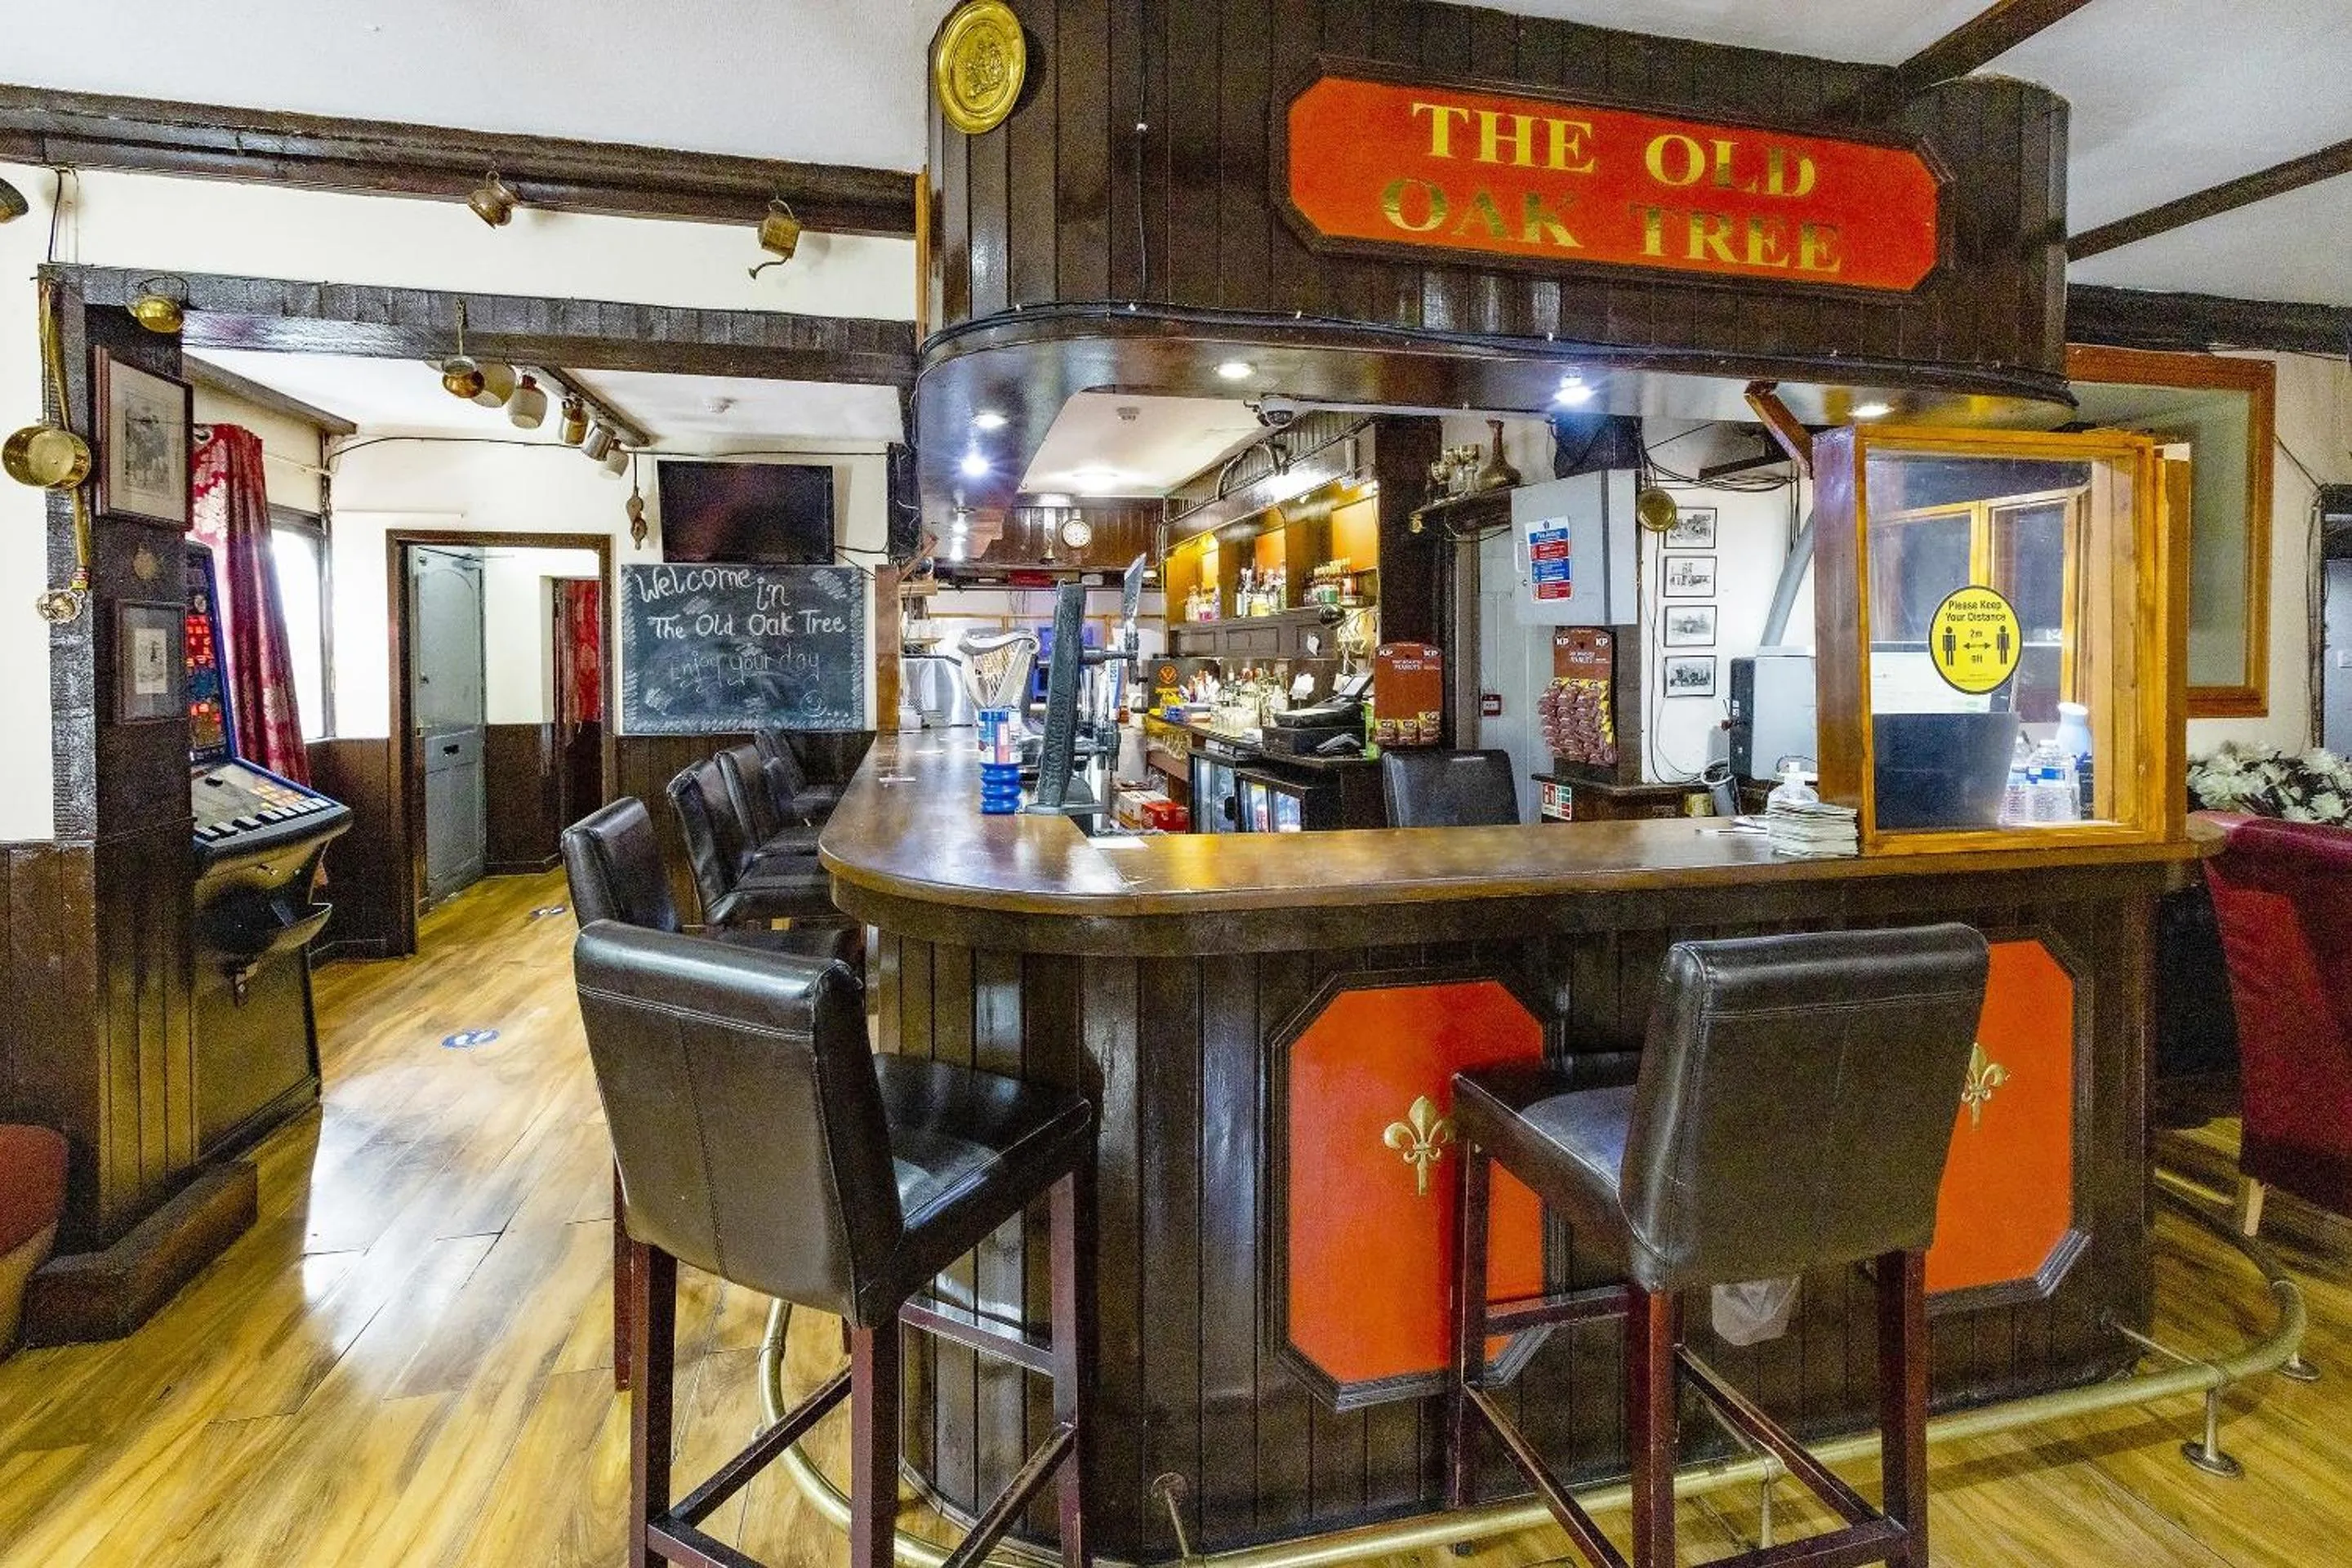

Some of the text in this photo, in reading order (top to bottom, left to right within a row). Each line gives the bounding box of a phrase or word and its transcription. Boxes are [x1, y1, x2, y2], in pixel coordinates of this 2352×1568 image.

[1410, 102, 1816, 197] THE OLD
[1380, 178, 1842, 273] OAK TREE
[635, 566, 791, 610] Welcome in
[1949, 599, 2002, 610] Please Keep
[1946, 612, 2006, 622] Your Distance
[648, 609, 846, 639] The Old Oak Tree
[1557, 637, 1569, 646] KP
[1595, 637, 1608, 647] KP
[1379, 648, 1393, 657] KP
[1423, 648, 1439, 657] KP
[779, 643, 820, 682] day
